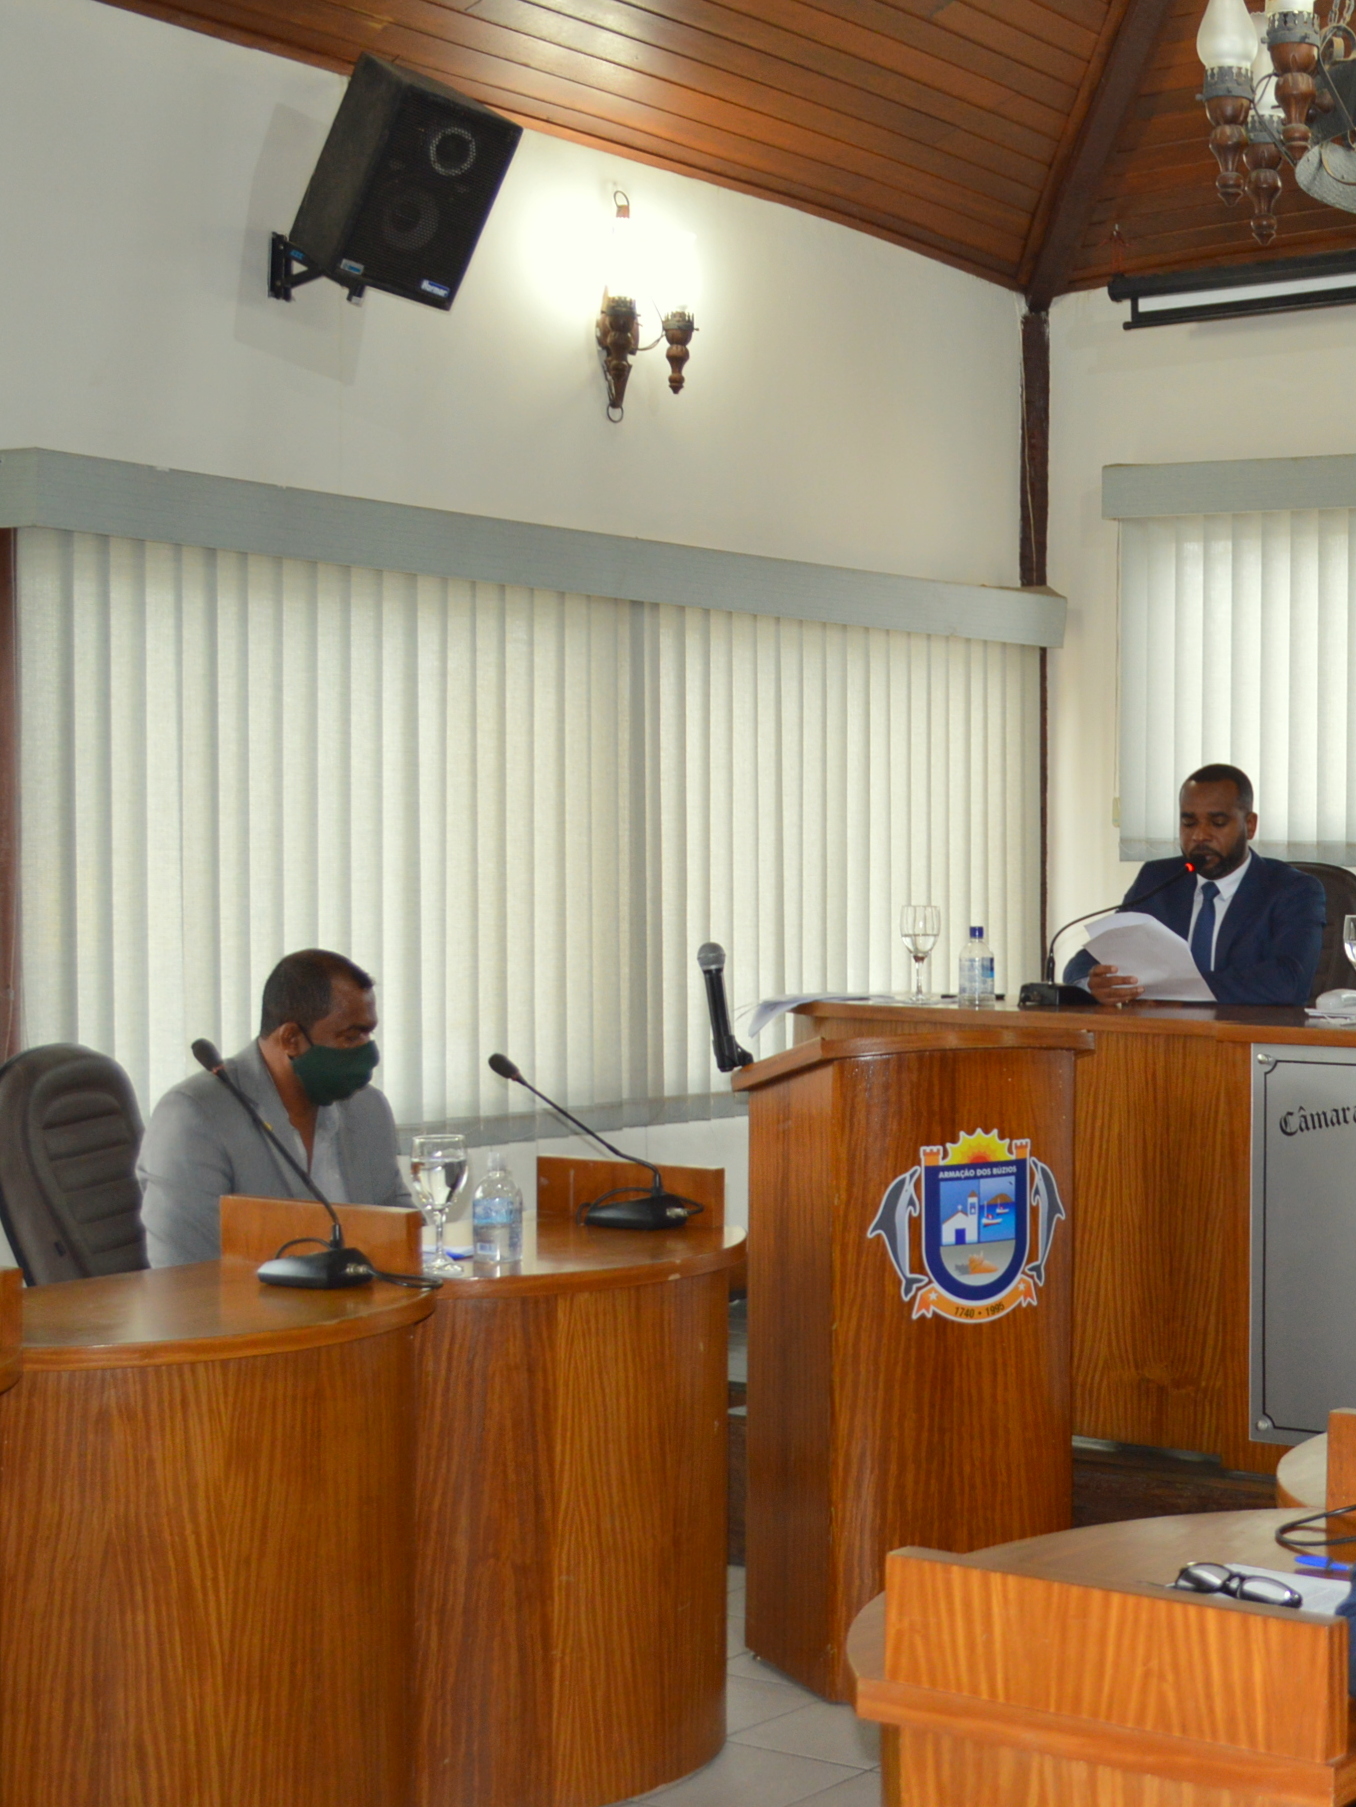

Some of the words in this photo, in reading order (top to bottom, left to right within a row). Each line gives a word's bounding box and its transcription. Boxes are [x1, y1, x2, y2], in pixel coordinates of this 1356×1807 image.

[938, 1168, 975, 1179] ARMAÇÃO
[976, 1168, 991, 1176] DOS
[992, 1165, 1017, 1175] BÚZIOS
[954, 1306, 975, 1318] 1740
[986, 1301, 1005, 1316] 1995
